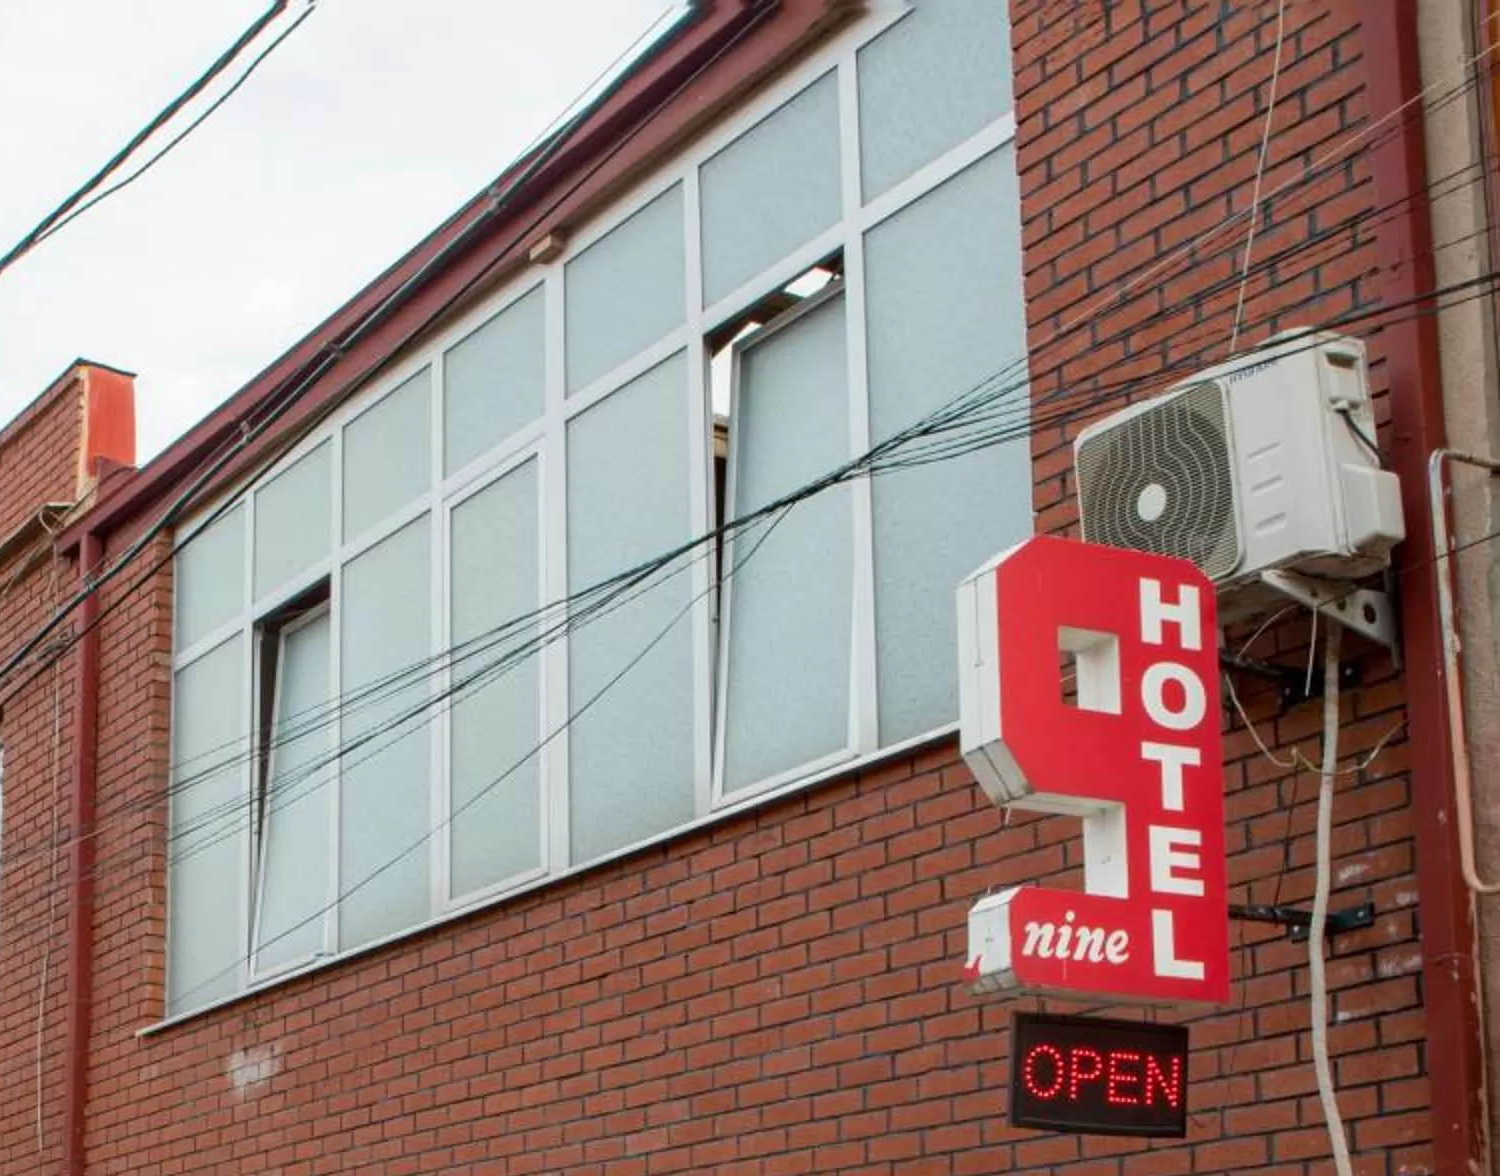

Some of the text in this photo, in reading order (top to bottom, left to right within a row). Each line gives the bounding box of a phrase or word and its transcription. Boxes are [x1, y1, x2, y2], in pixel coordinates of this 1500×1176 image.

[1139, 577, 1207, 980] HOTEL
[1022, 911, 1130, 964] nine
[1023, 1044, 1181, 1107] OPEN
